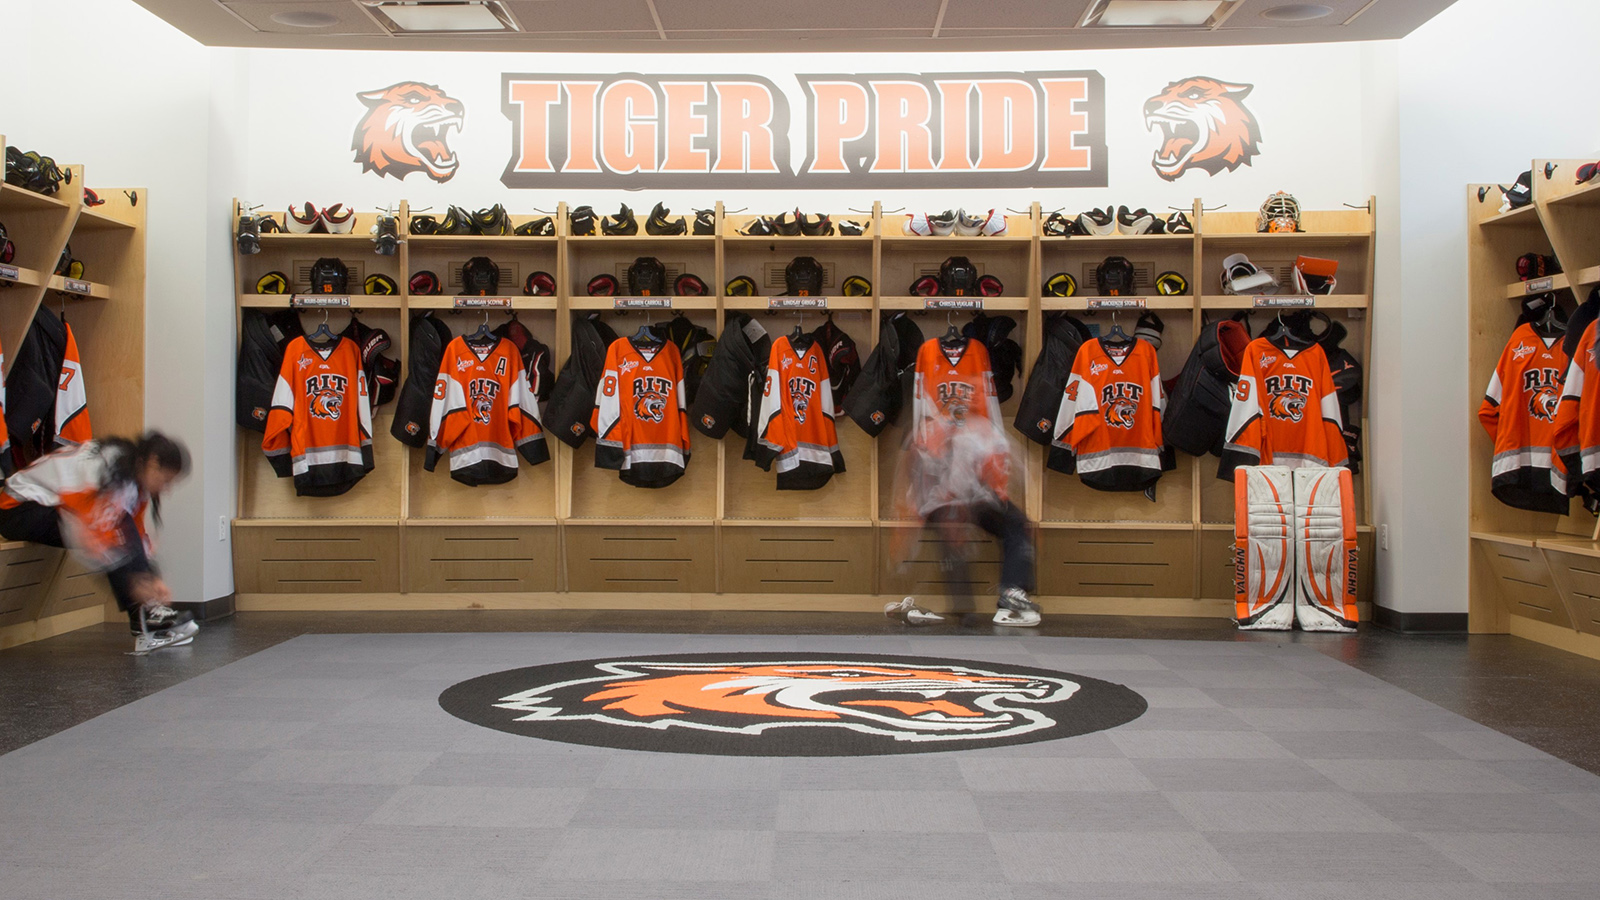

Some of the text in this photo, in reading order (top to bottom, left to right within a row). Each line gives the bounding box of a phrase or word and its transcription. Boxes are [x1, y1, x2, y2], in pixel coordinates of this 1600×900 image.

[508, 77, 1092, 174] TIGER PRIDE
[341, 298, 348, 306] 15
[505, 299, 511, 307] 3
[663, 299, 670, 307] 18
[817, 299, 825, 307] 23
[1138, 300, 1145, 308] 14
[1305, 298, 1313, 306] 39
[495, 356, 508, 377] A
[808, 355, 818, 374] C
[58, 366, 76, 392] 7
[305, 373, 349, 397] RIT
[433, 379, 447, 400] 3
[468, 378, 501, 400] RIT
[602, 375, 617, 397] 8
[633, 376, 673, 398] RIT
[788, 377, 816, 399] RIT
[1264, 374, 1314, 396] RIT
[936, 381, 975, 403] RIT
[1065, 379, 1080, 402] 4
[1101, 381, 1144, 406] RIT
[1235, 379, 1251, 402] 9
[1236, 547, 1246, 595] VAUGHN
[1347, 548, 1357, 596] VAUGHN
